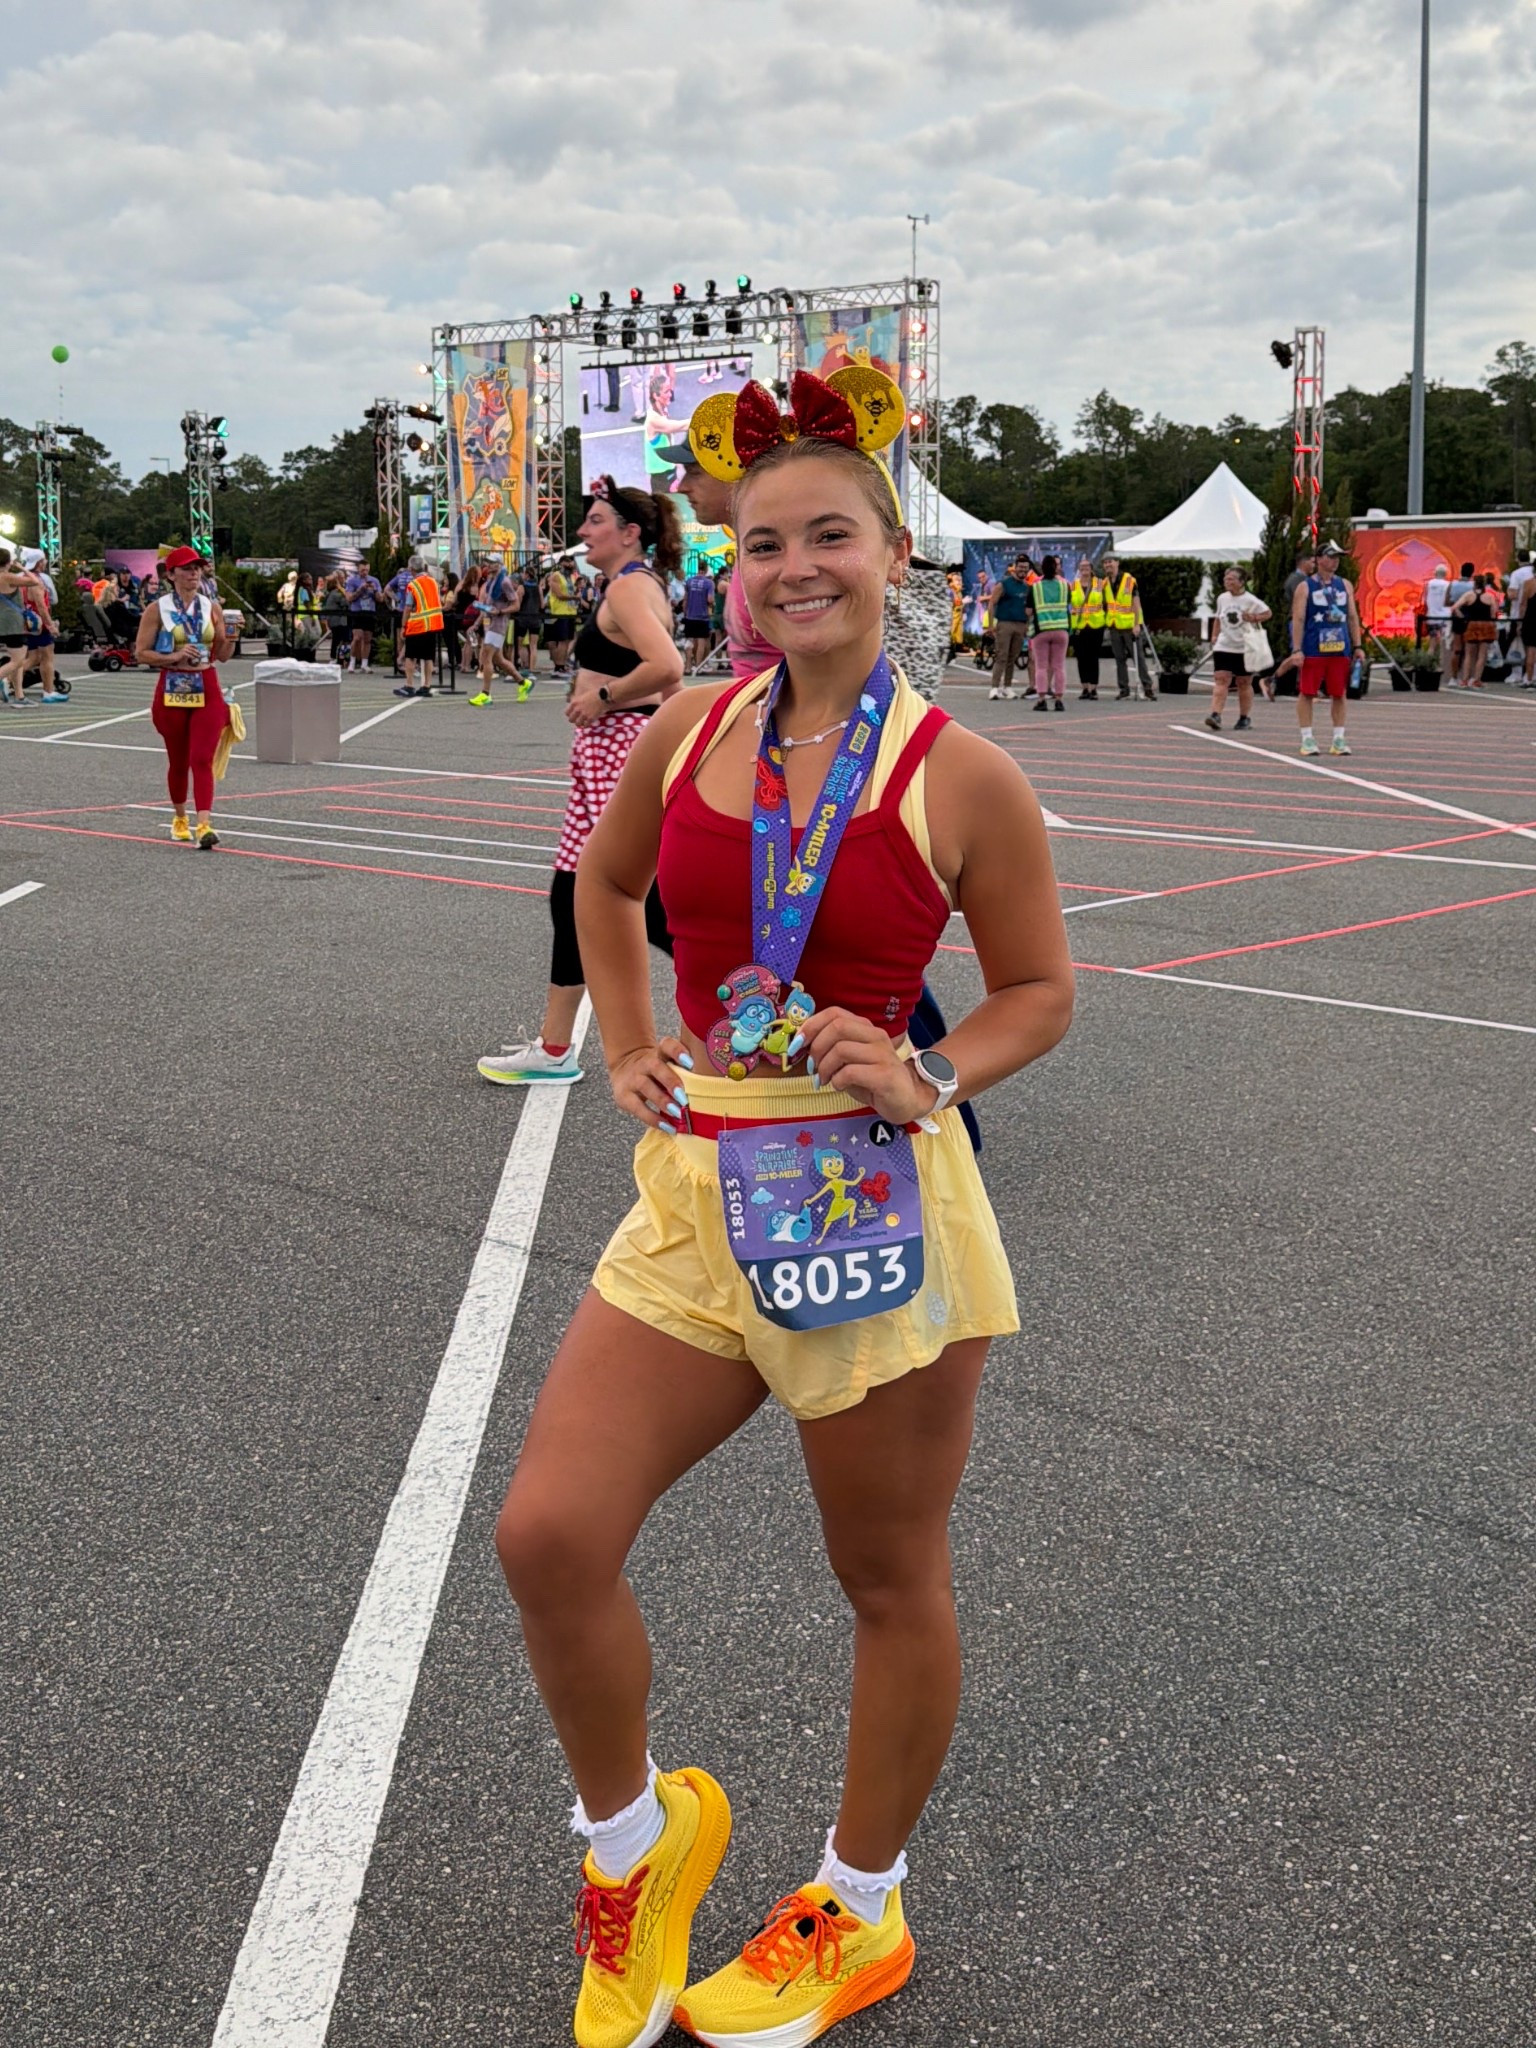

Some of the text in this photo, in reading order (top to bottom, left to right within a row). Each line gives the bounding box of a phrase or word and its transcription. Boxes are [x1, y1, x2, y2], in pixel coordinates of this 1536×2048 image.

[498, 369, 508, 379] 5K
[823, 755, 849, 798] SURPRISE
[803, 803, 838, 867] 10-MILER
[875, 1125, 892, 1143] A
[757, 1160, 797, 1172] SURPRISE
[769, 1169, 803, 1181] 10-MILER
[726, 1178, 745, 1240] 18053
[863, 1198, 872, 1208] 5
[748, 1245, 907, 1310] 18053
[640, 1913, 649, 1944] BROOKS
